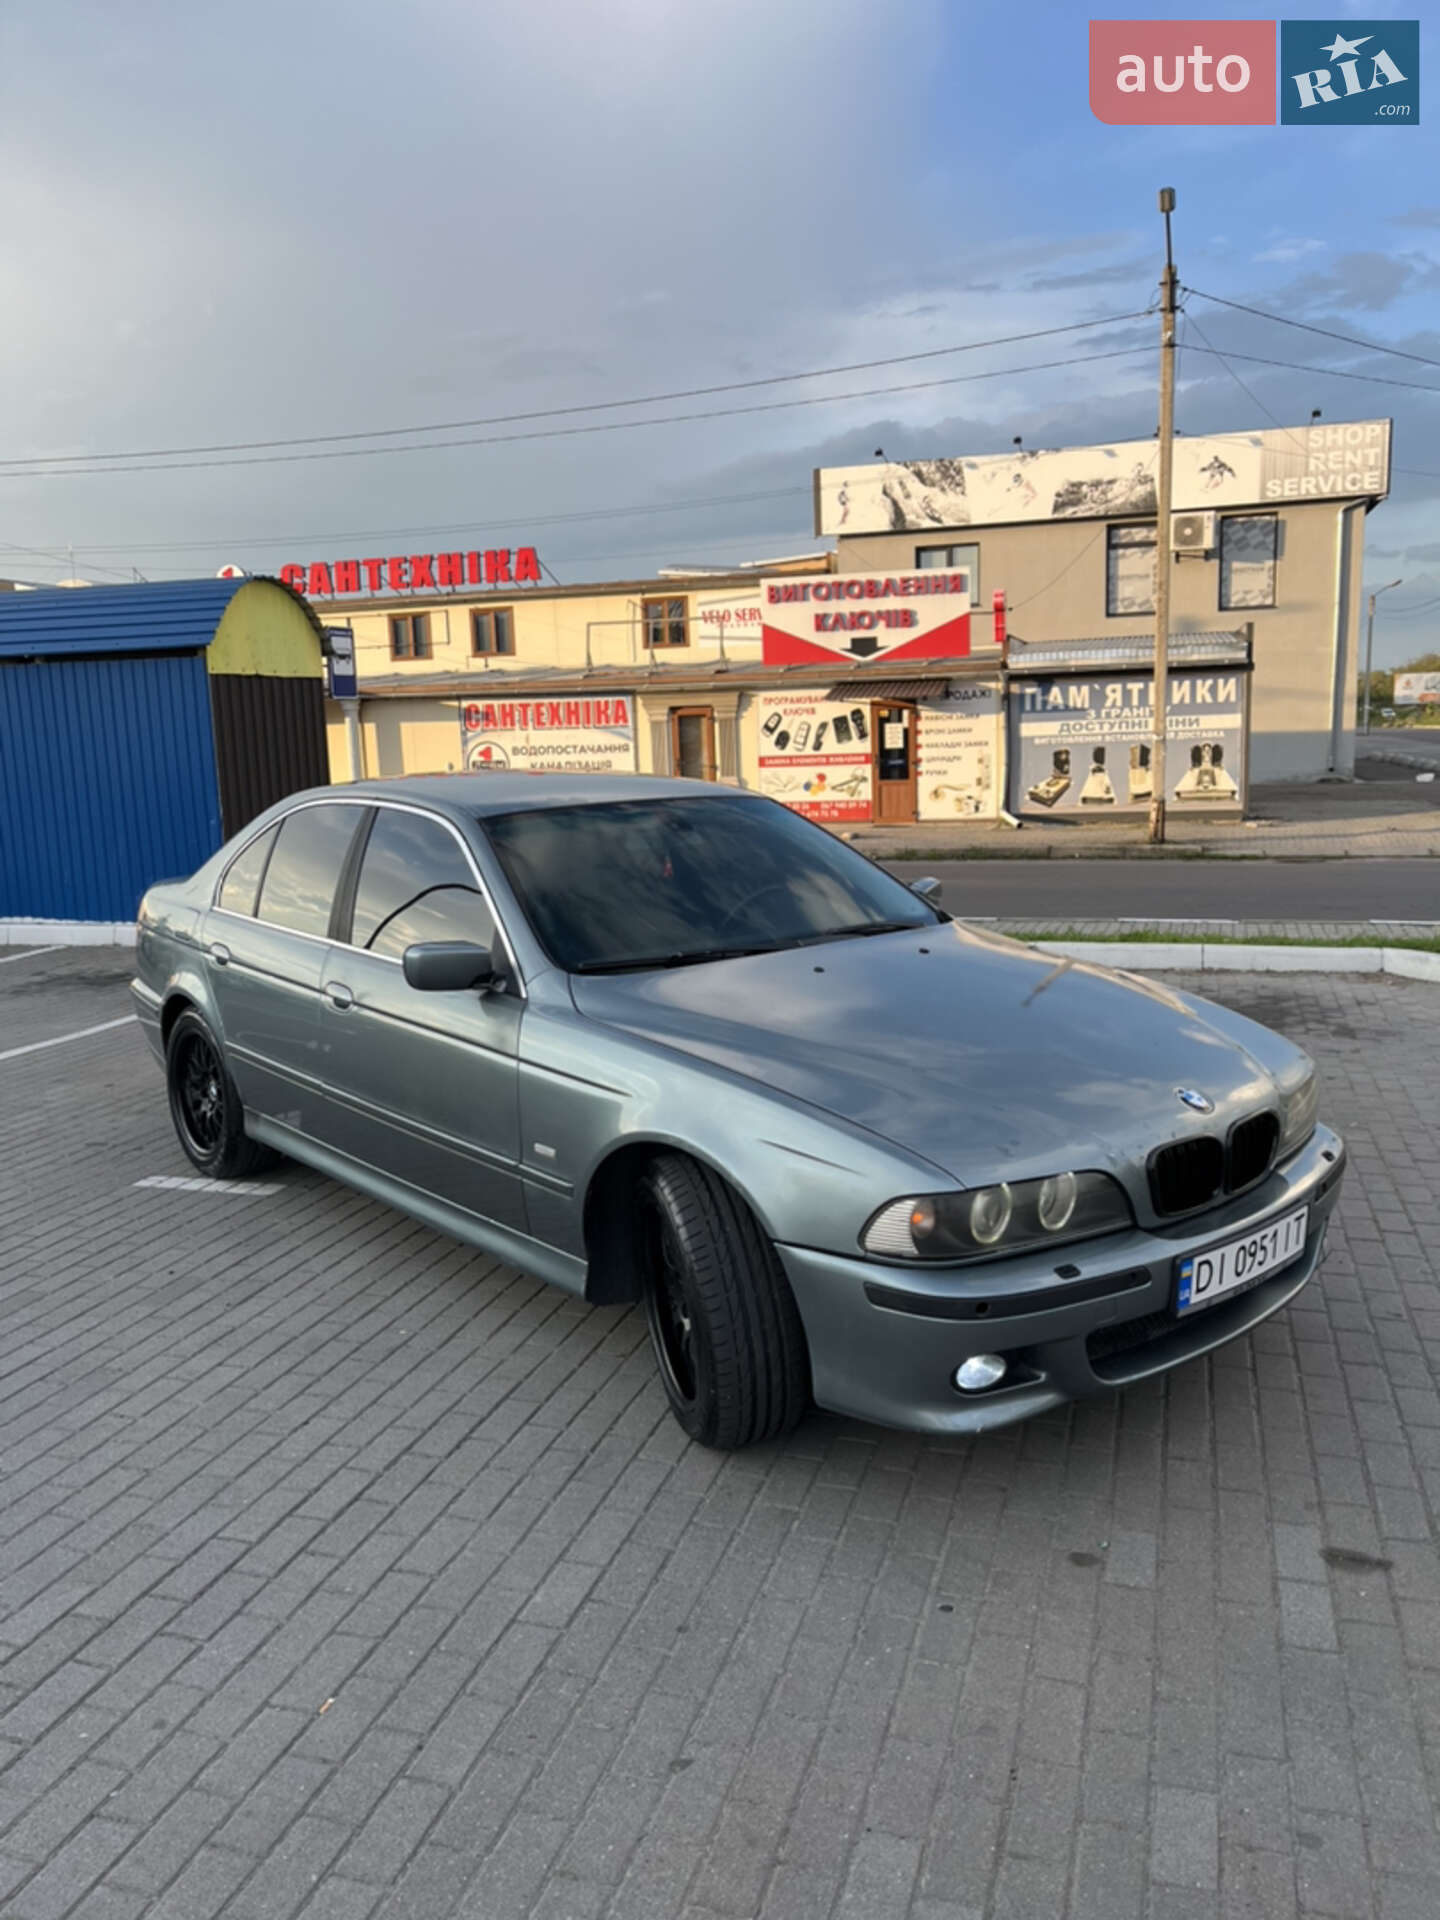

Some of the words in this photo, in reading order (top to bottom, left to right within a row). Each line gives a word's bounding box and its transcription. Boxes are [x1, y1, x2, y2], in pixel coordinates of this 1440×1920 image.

[1308, 426, 1381, 448] SHOP
[1308, 448, 1381, 471] RENT
[1265, 471, 1380, 498] SERVICE
[280, 547, 540, 596] САНТЕХНІКА
[767, 573, 965, 604] ВИГОТОВЛЕННЯ
[814, 609, 916, 632] КЛЮЧІВ
[465, 699, 629, 731] САНТЕХНІКА
[1058, 719, 1149, 735] ДОСТУПНІ
[1168, 717, 1201, 729] ІНИ
[512, 743, 630, 757] ВОДОПОСТАЧАННЯ
[1194, 1253, 1225, 1294] DI
[1234, 1228, 1278, 1277] 0951
[1285, 1213, 1305, 1251] IT
